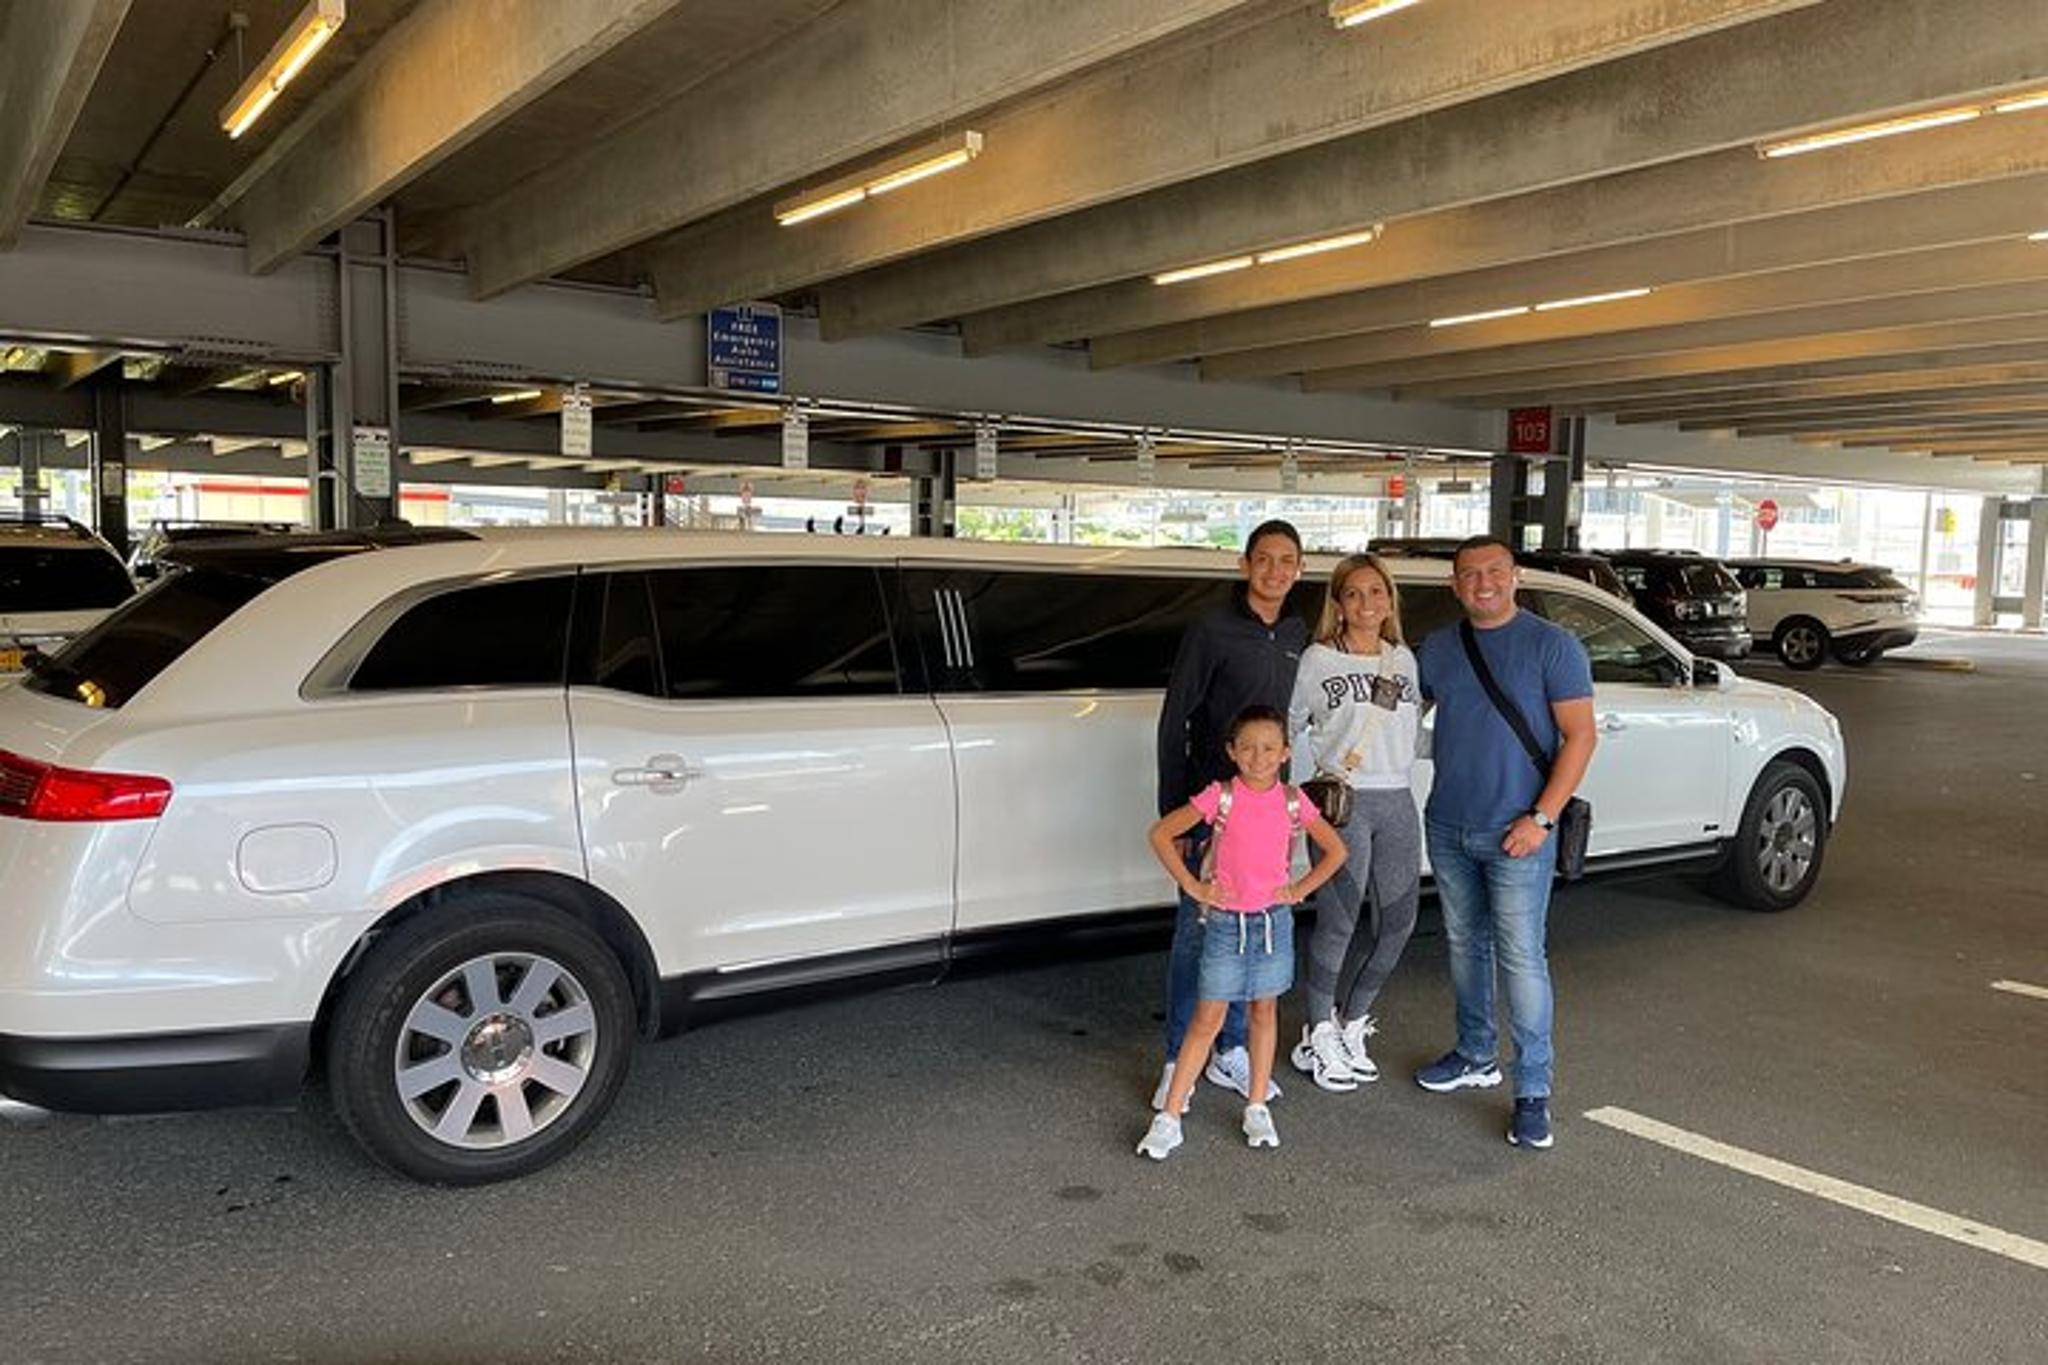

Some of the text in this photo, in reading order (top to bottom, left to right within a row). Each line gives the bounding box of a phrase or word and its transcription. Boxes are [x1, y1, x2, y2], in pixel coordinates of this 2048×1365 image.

[713, 330, 776, 350] Emergency
[714, 354, 775, 369] Assistance
[1515, 422, 1547, 442] 103
